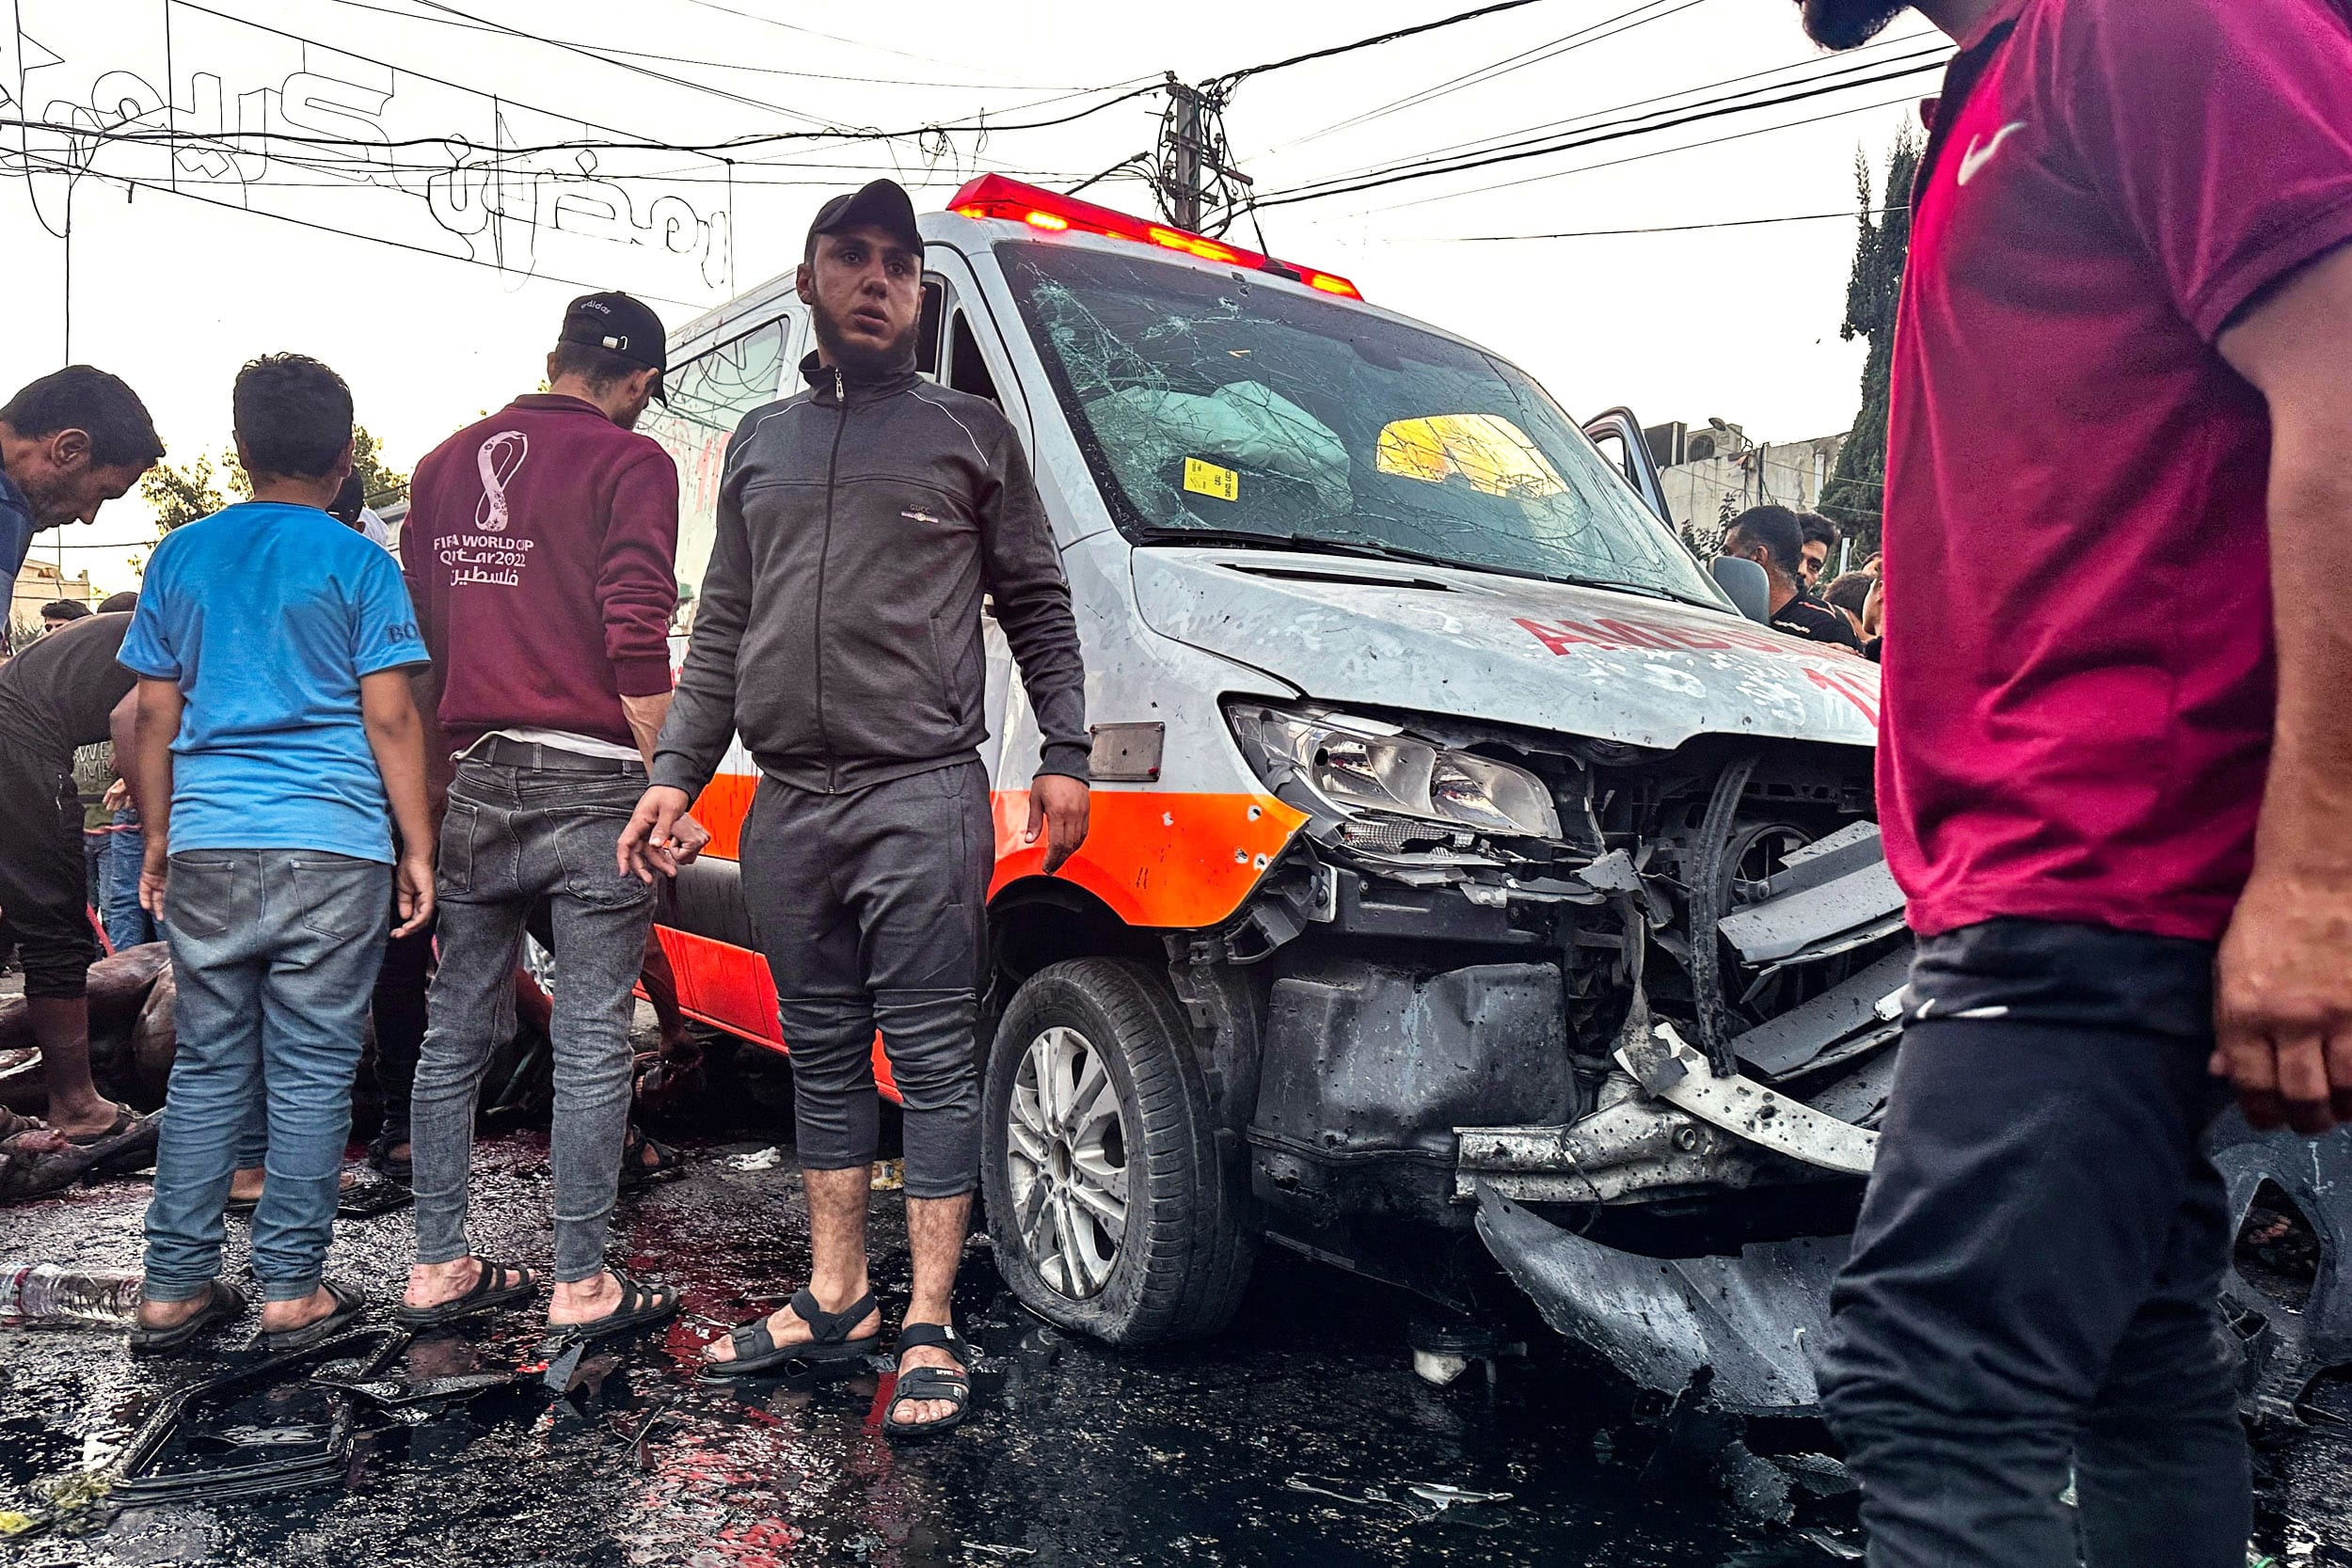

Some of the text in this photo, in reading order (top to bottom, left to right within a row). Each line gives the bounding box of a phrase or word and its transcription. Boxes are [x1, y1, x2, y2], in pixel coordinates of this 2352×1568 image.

[434, 534, 459, 550] FIFA
[462, 534, 515, 550] WORLD
[451, 566, 519, 586] فلسطين
